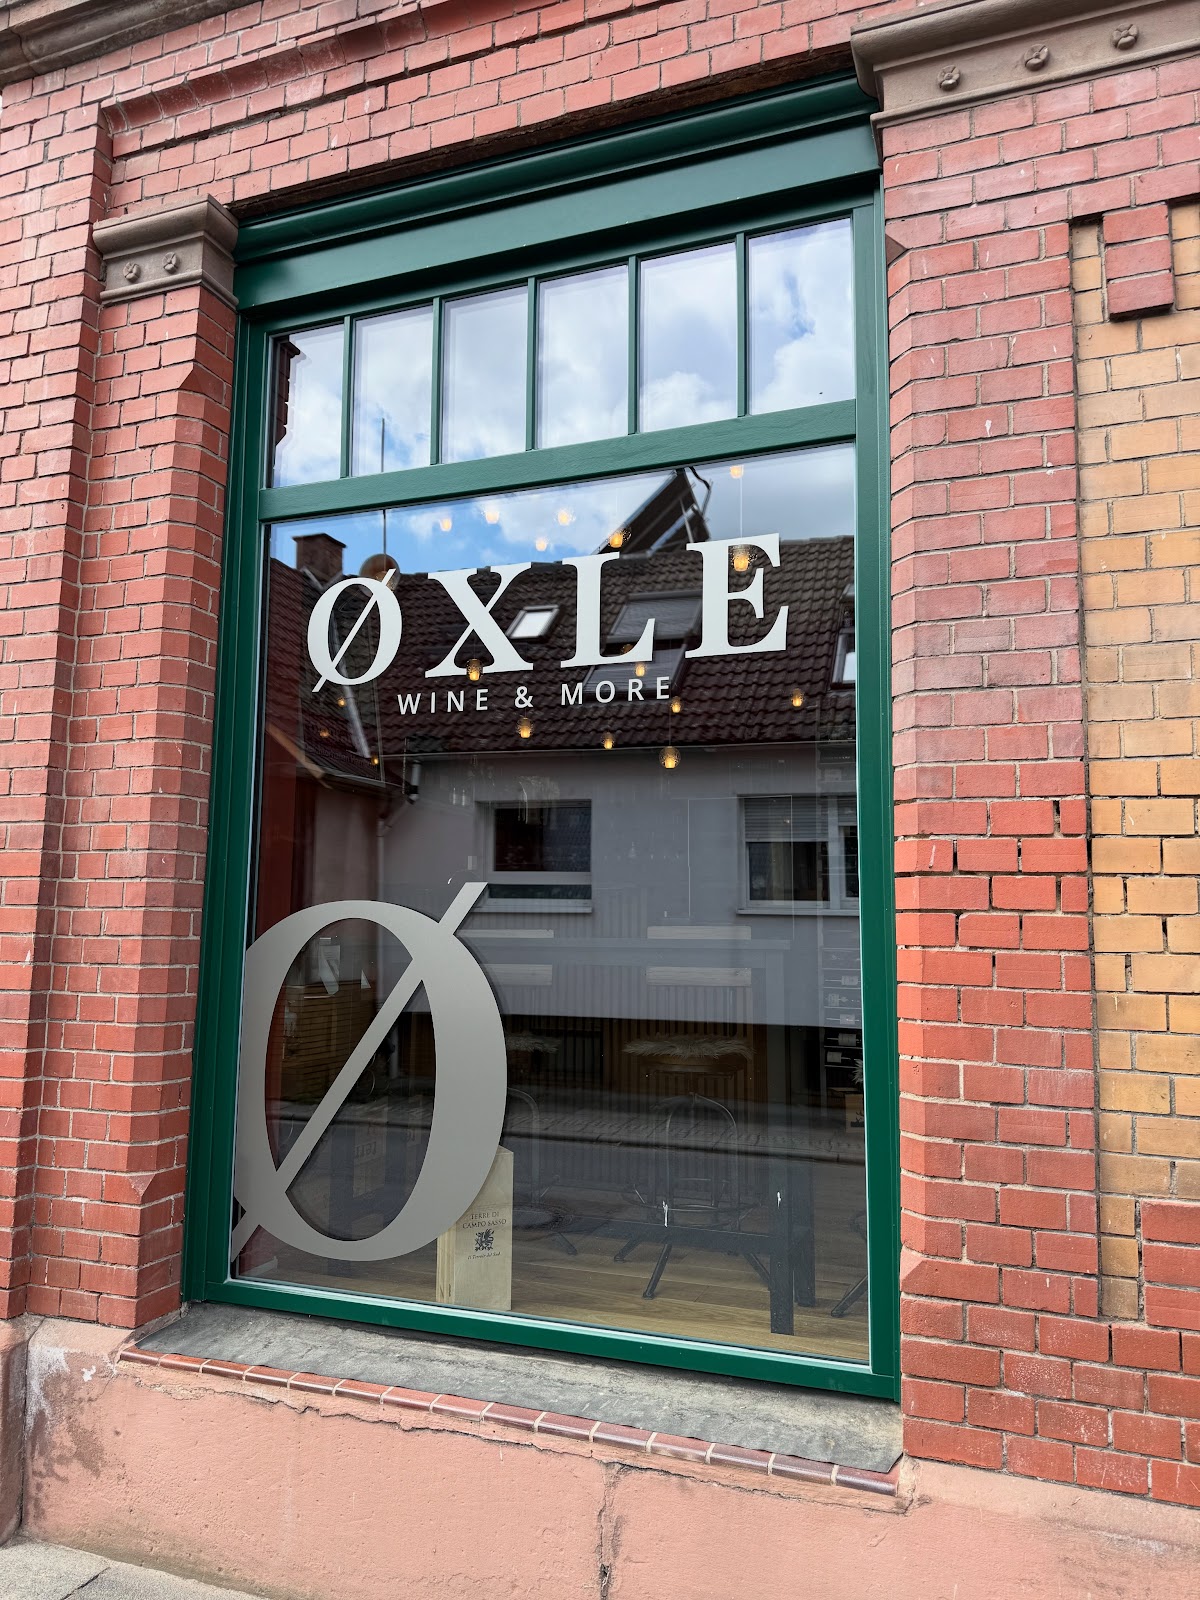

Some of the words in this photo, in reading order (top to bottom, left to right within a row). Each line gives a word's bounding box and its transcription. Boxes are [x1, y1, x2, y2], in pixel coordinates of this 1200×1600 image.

[307, 532, 789, 692] ØXLE
[397, 689, 490, 716] WINE
[513, 686, 534, 709] &
[561, 676, 671, 706] MORE
[462, 1220, 487, 1229] CAMPO
